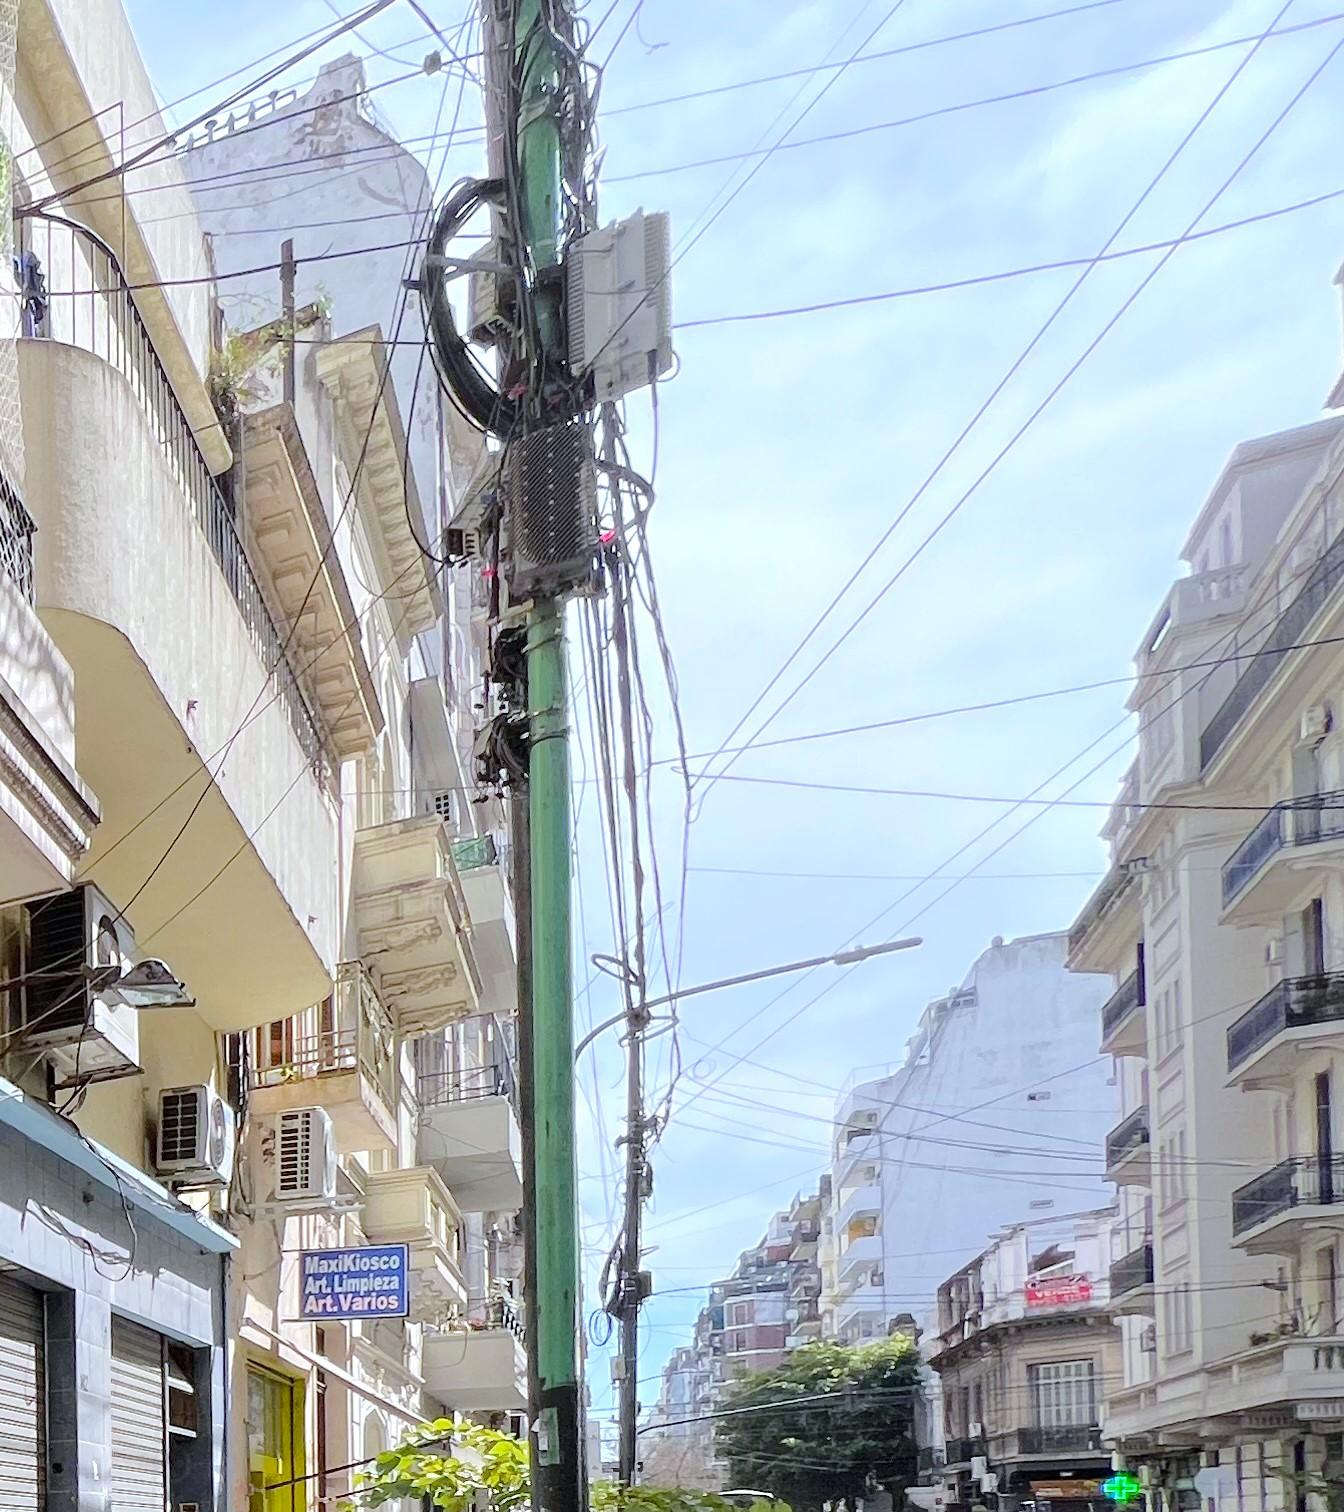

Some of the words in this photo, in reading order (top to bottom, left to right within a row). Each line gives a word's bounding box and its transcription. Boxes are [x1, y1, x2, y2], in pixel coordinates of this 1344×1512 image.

[305, 1254, 400, 1274] MaxiKiosco
[305, 1275, 332, 1294] Art.
[334, 1274, 400, 1296] Limpieza
[304, 1295, 338, 1313] Art.
[339, 1293, 399, 1312] Varios
